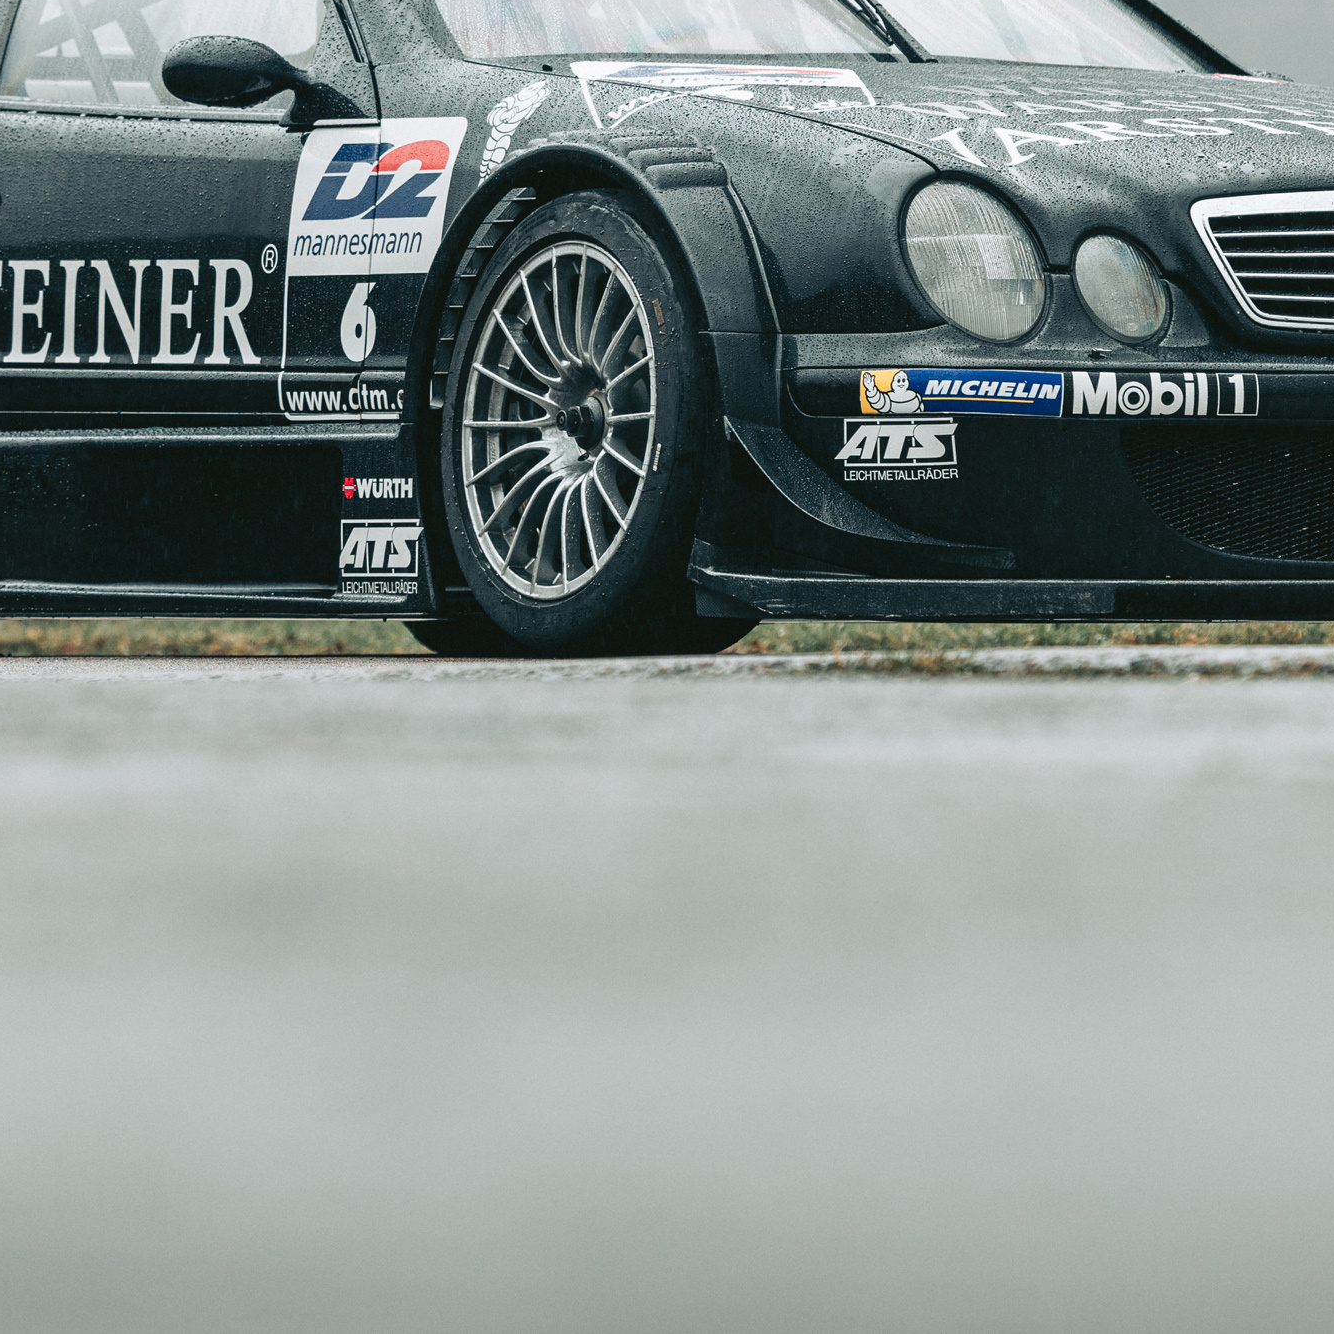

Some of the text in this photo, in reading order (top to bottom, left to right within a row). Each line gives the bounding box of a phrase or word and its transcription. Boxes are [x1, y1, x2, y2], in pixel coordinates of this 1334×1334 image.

[302, 139, 450, 221] D2
[293, 231, 423, 257] mannesmann
[340, 282, 377, 363] 6
[924, 379, 1061, 400] MICHELIN
[1072, 372, 1245, 416] Mobil 1
[835, 423, 958, 460] ATS
[356, 477, 414, 499] WÜRTH
[844, 468, 959, 481] LEICHTMETALLRÄDER
[339, 527, 424, 568] ATS
[342, 579, 418, 594] LEICHTMETALLRÄDER
